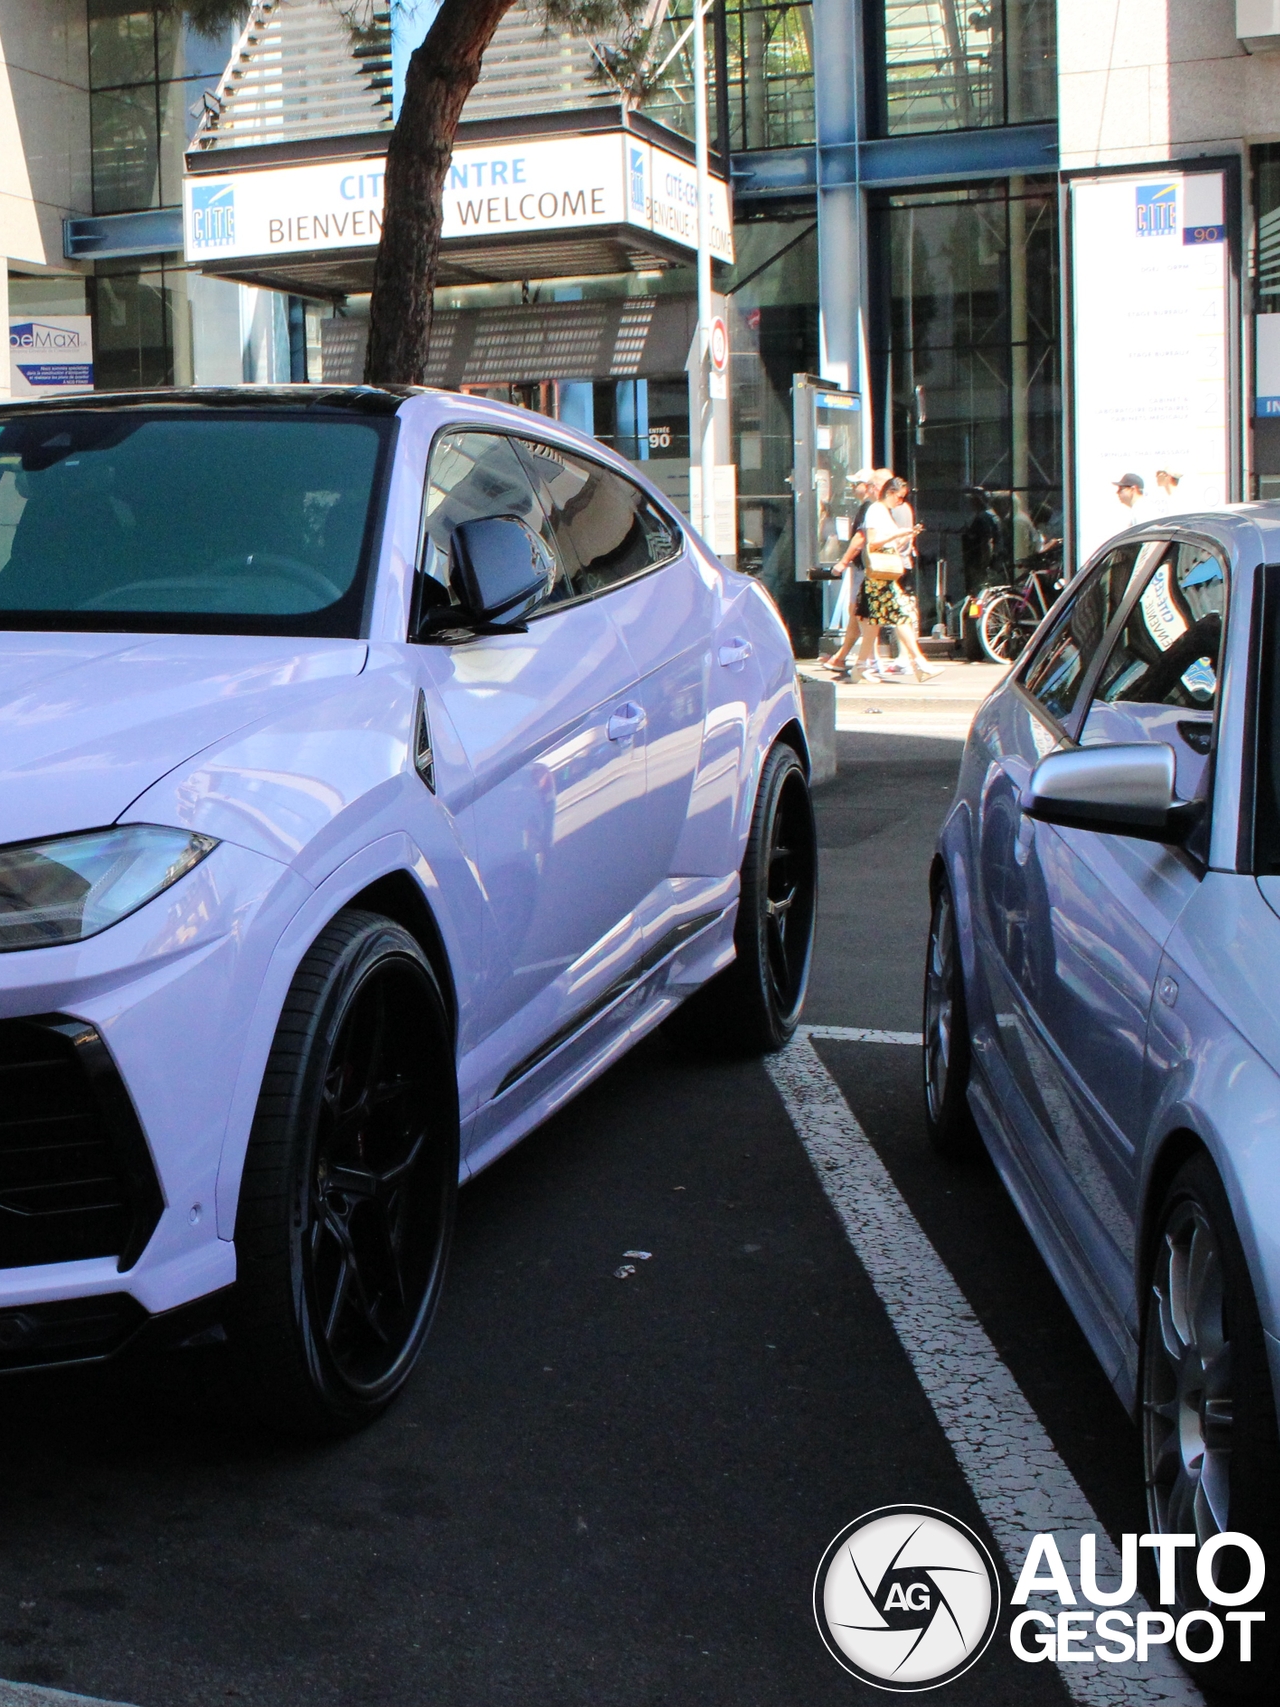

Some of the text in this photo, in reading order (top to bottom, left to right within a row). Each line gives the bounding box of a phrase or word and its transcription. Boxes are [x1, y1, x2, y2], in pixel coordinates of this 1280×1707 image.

[666, 173, 713, 216] CITÉ-CEE
[193, 206, 234, 240] CITE
[269, 188, 605, 244] BIENVEN WELCOME
[1137, 202, 1176, 230] CITE
[1194, 228, 1218, 242] 90
[649, 434, 670, 448] 90
